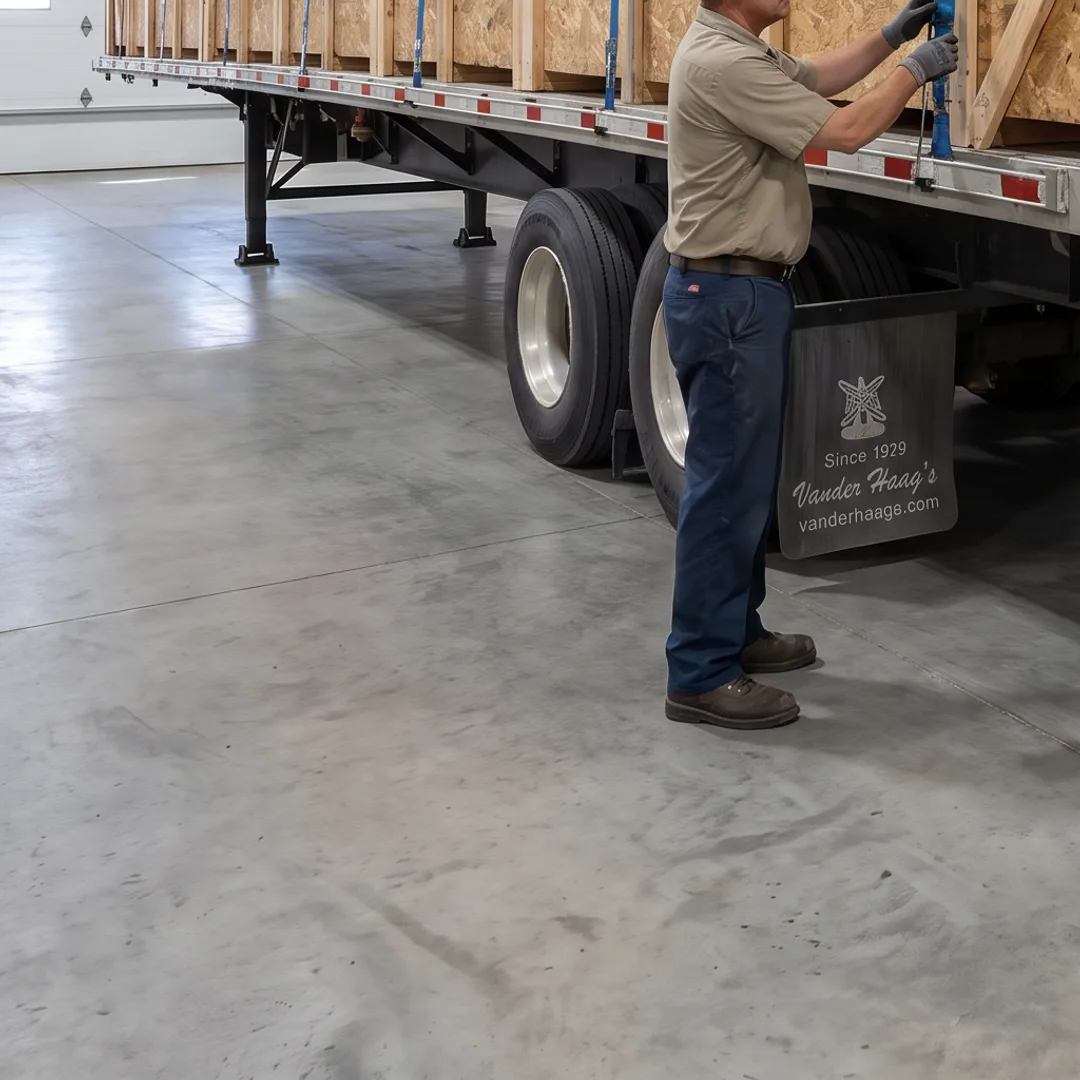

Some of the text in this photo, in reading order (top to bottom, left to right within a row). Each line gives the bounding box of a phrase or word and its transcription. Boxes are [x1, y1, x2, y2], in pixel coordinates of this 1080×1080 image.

[824, 441, 906, 468] Since 1929
[792, 476, 861, 508] Vander
